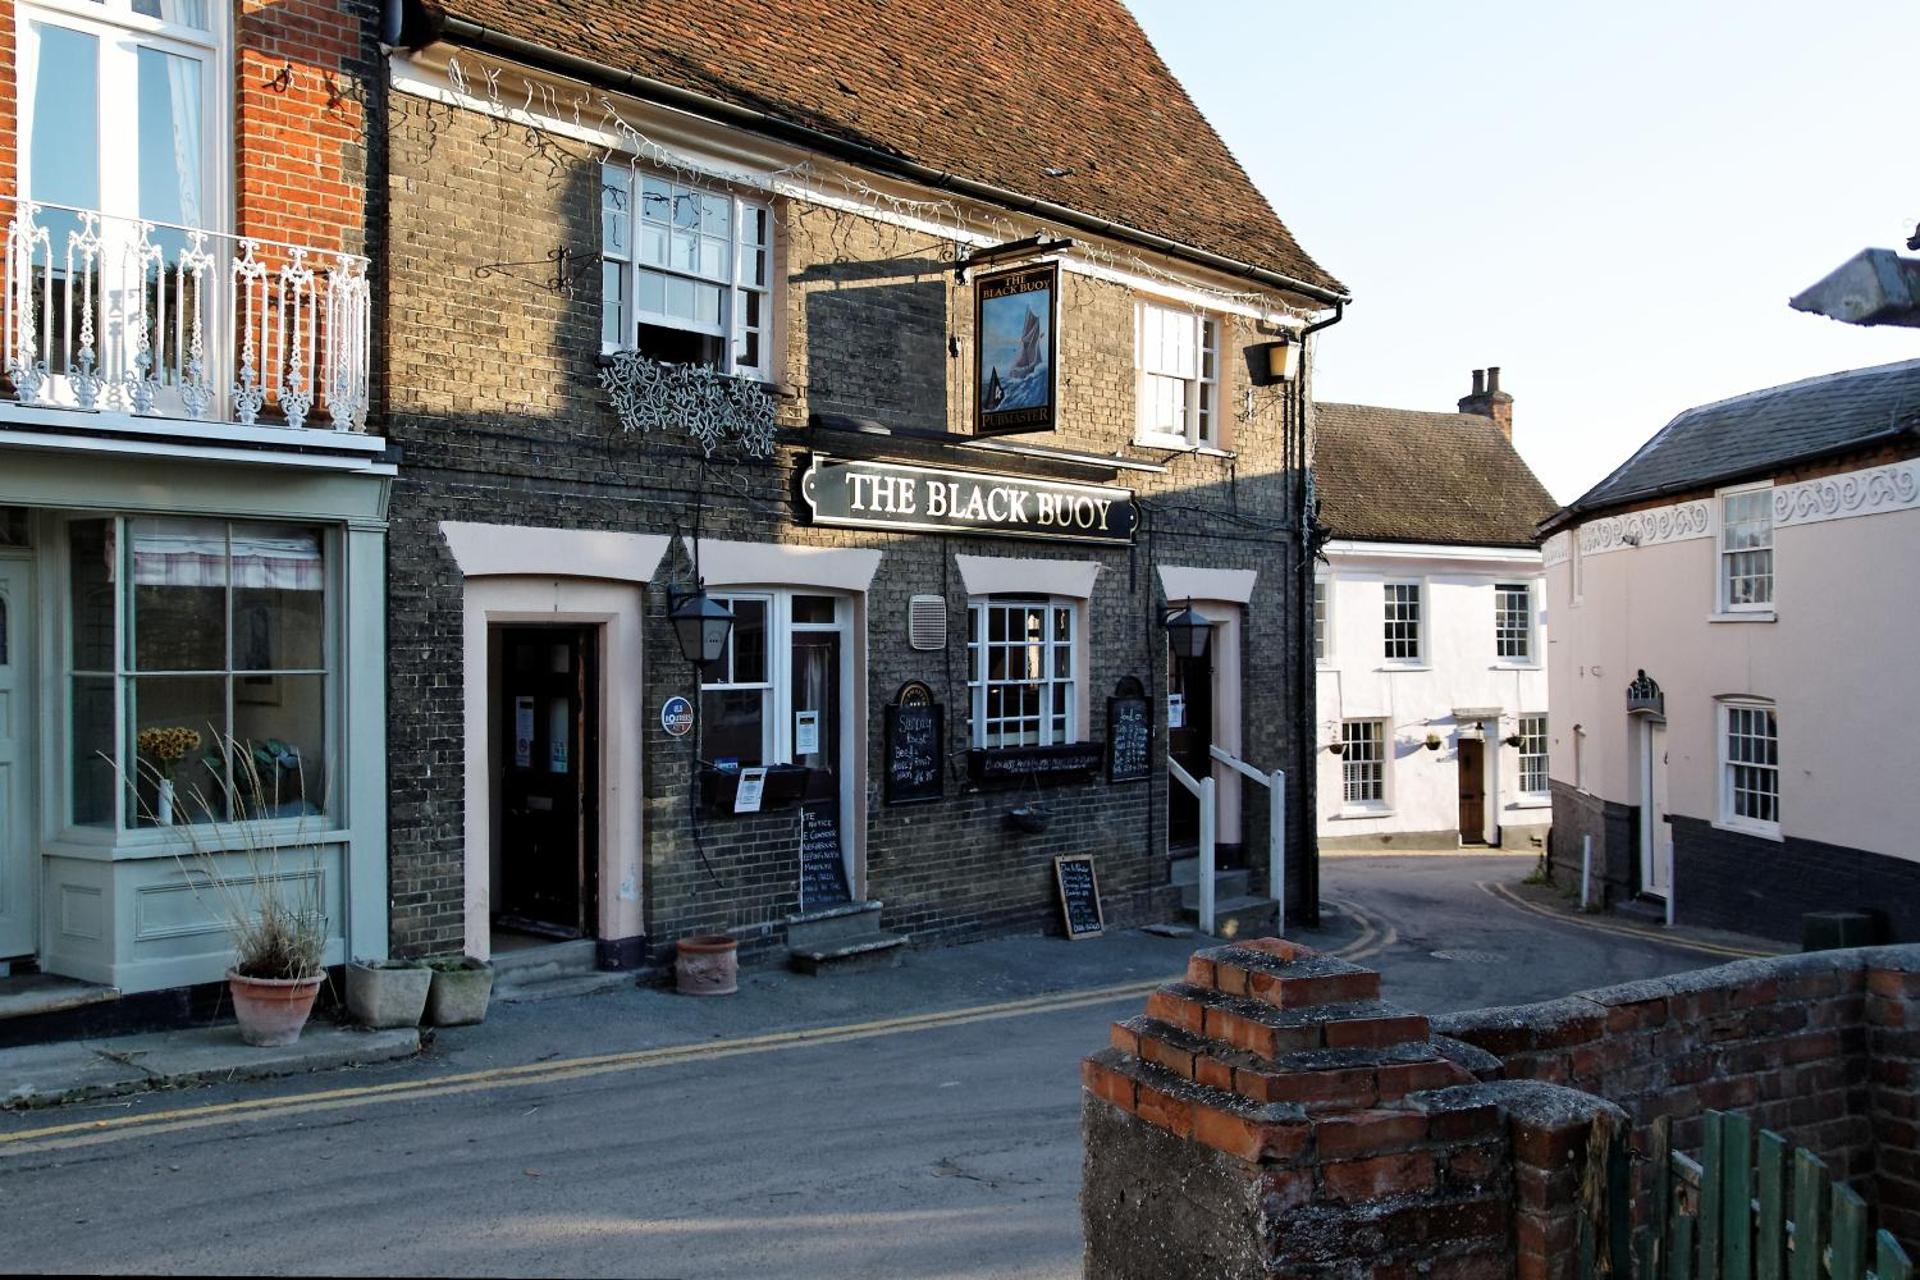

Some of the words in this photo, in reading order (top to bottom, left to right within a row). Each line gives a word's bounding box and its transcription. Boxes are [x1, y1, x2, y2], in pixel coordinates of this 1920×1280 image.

[983, 285, 1017, 299] BLACK
[1019, 279, 1050, 293] BUOY
[1006, 273, 1025, 287] THE
[845, 472, 916, 514] THE
[926, 480, 1029, 523] BLACK
[1036, 492, 1112, 531] BUOY
